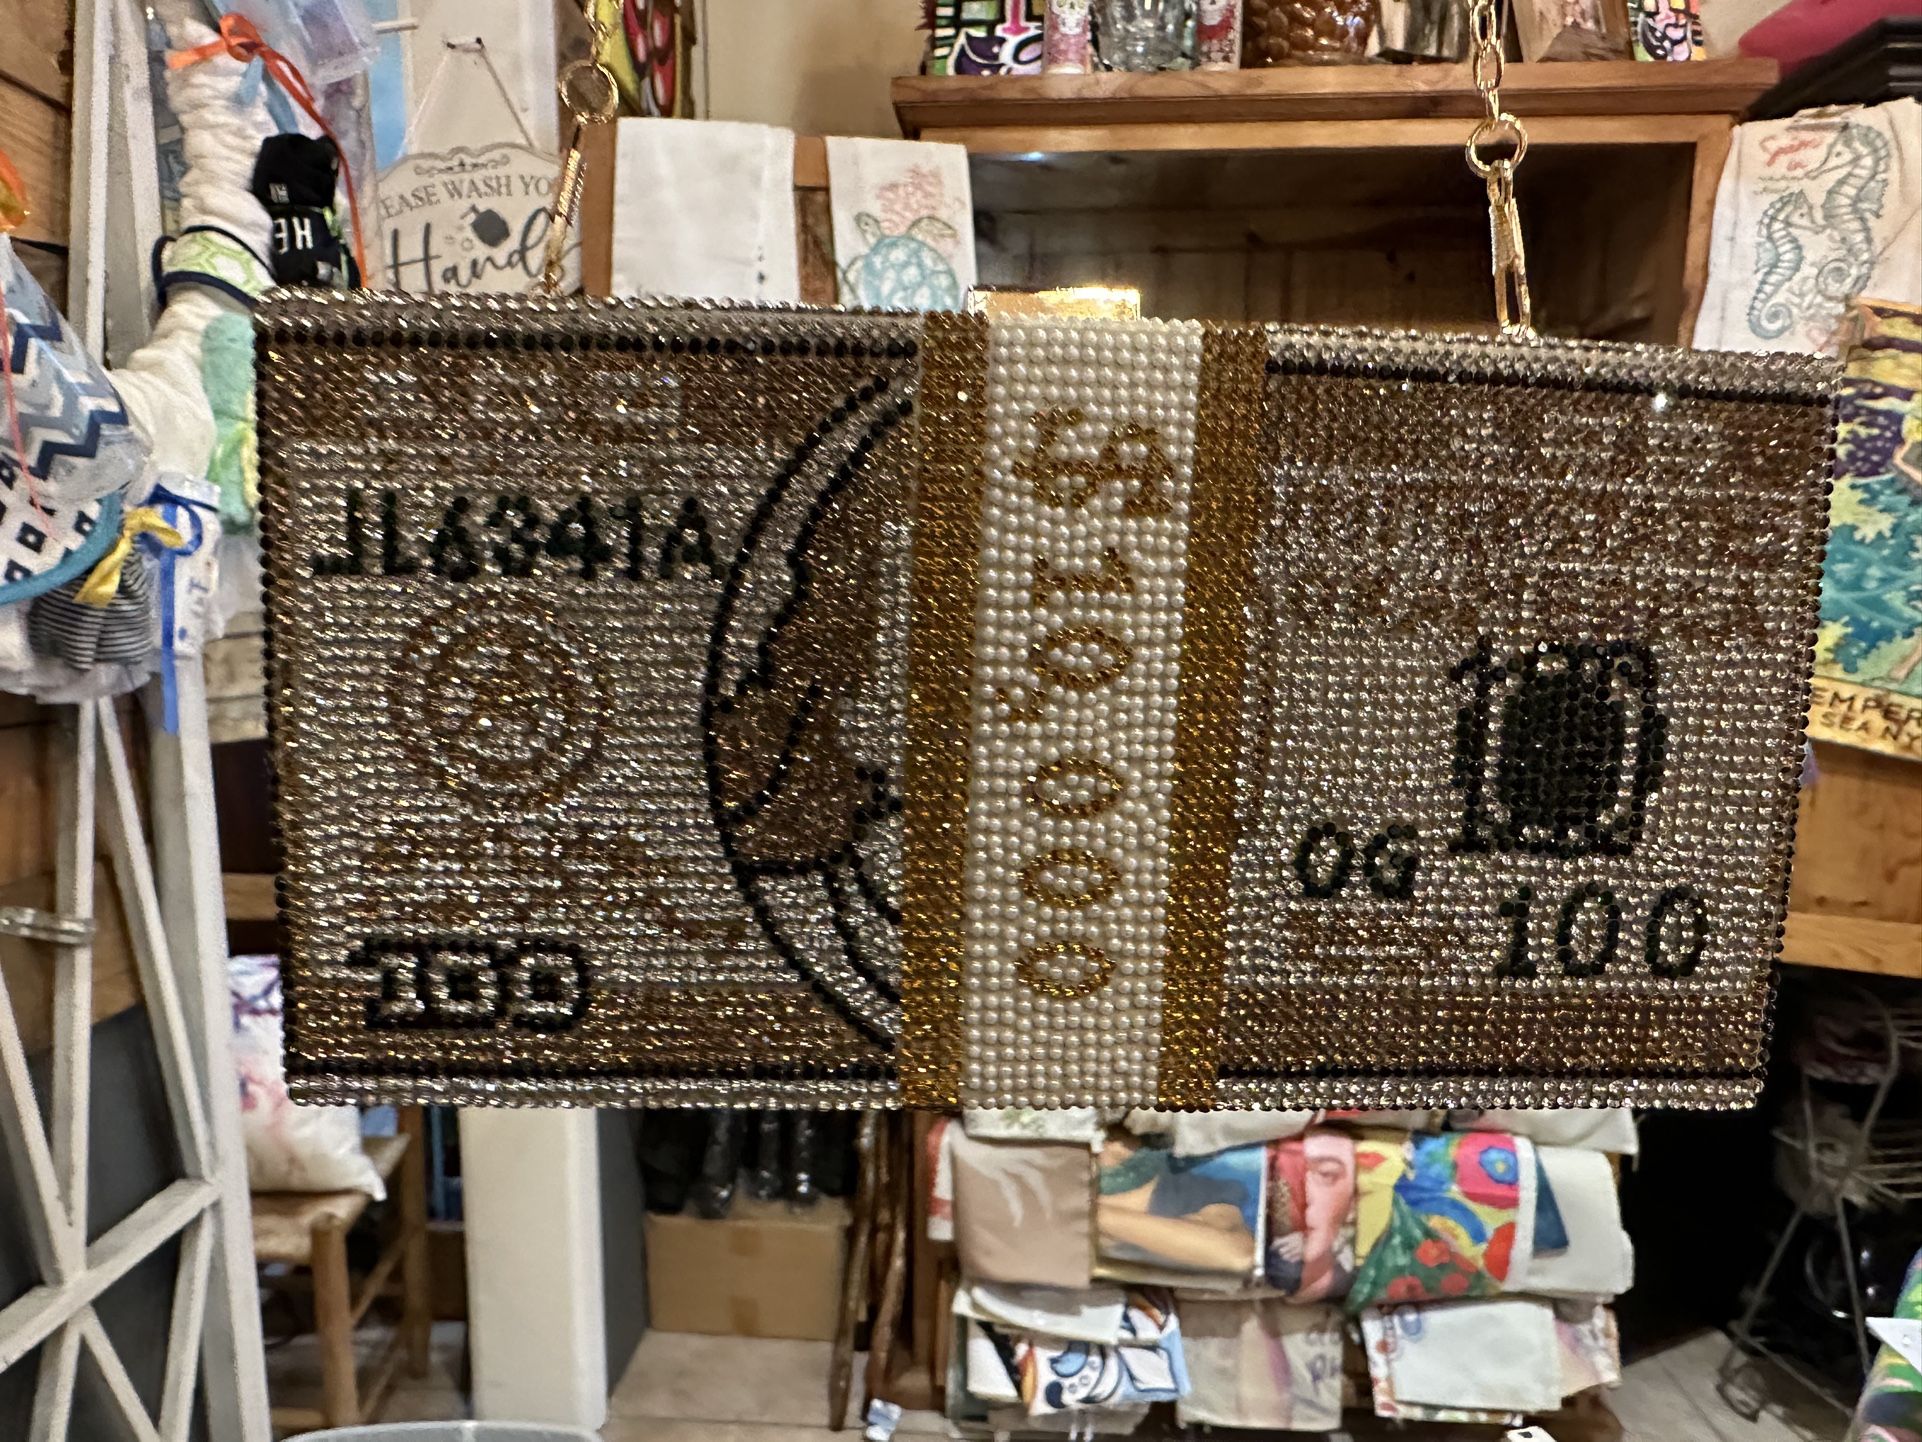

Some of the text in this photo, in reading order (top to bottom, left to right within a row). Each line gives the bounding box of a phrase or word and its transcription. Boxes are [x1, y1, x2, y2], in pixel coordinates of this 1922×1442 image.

[380, 184, 438, 220] EASE
[442, 174, 513, 200] WASH
[1497, 883, 1707, 979] 100
